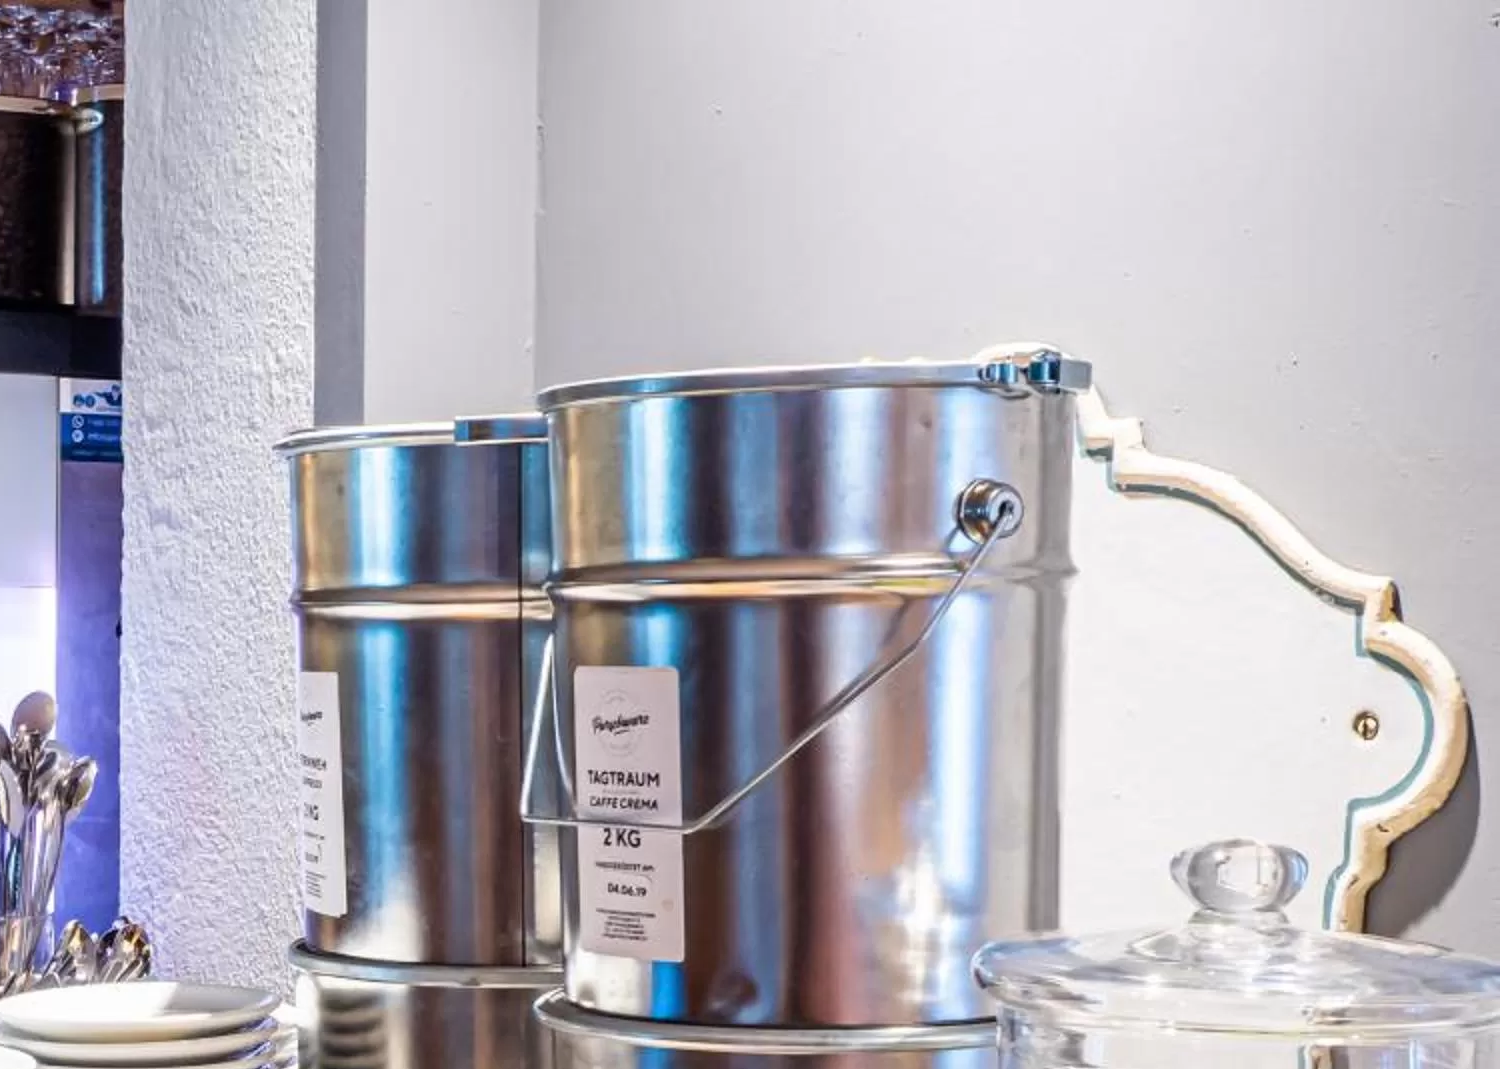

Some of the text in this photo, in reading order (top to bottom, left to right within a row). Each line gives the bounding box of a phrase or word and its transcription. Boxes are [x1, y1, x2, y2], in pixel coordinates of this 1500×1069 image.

[588, 769, 661, 787] TAGTRAUM
[619, 797, 658, 811] CREMA
[603, 827, 642, 848] 2 KG
